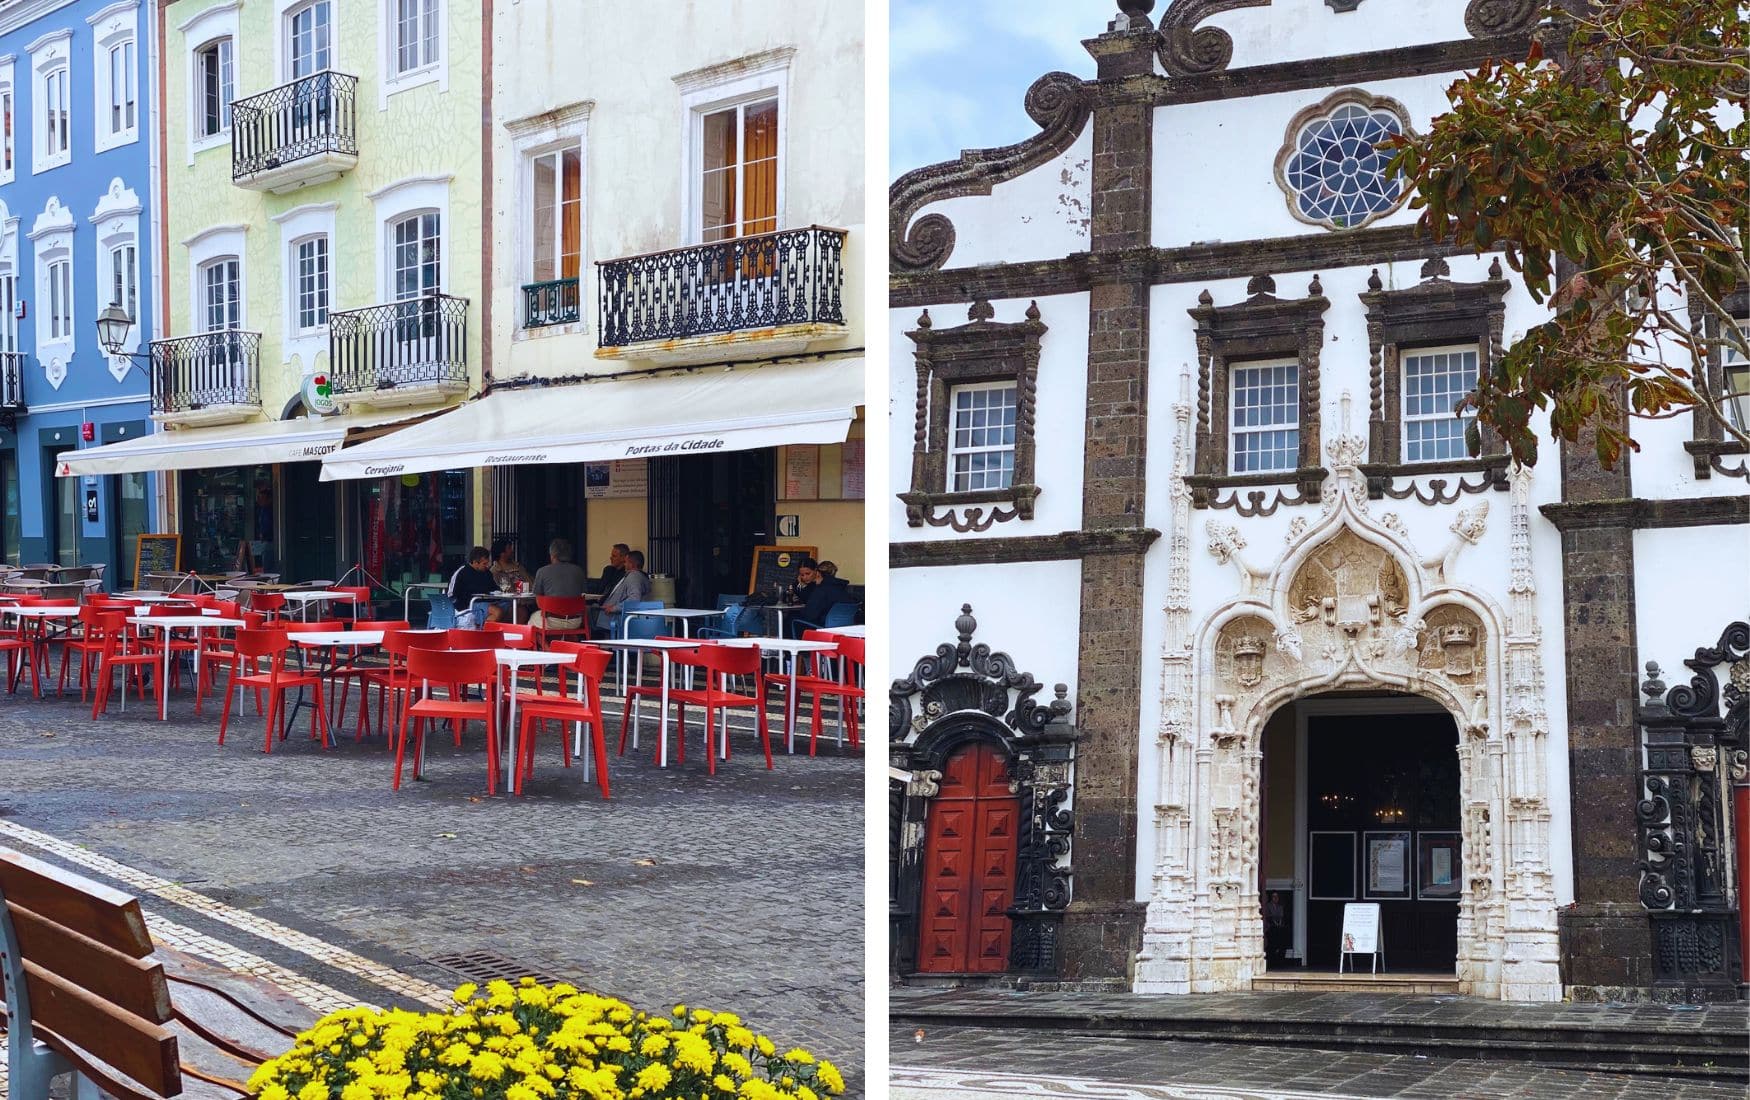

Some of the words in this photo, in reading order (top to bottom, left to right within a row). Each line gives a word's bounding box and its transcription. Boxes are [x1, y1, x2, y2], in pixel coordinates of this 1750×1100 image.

[315, 398, 333, 406] JOGOS
[625, 444, 661, 456] Portas
[663, 442, 680, 452] da
[680, 438, 724, 451] Cidade
[484, 454, 548, 464] Restaurante
[364, 464, 405, 476] Cervejaria
